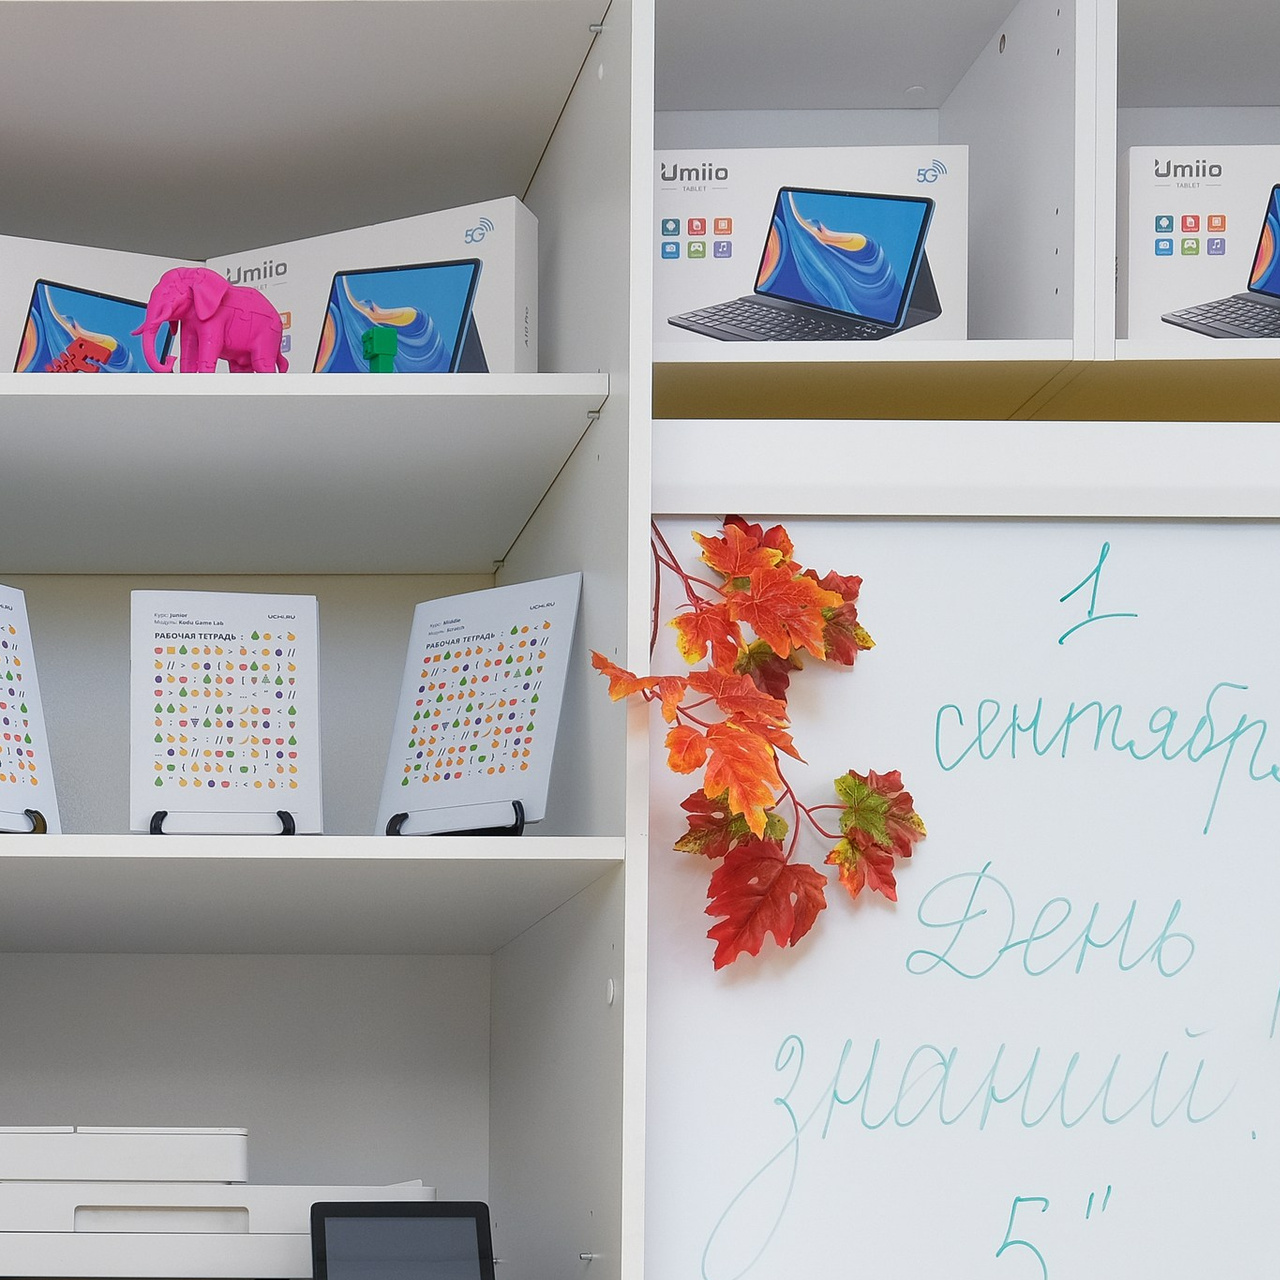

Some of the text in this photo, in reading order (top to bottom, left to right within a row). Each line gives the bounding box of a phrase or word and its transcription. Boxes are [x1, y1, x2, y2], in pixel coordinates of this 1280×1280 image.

[661, 162, 729, 182] Umiio
[1154, 158, 1222, 178] Umiio
[226, 260, 288, 285] Umiio
[154, 632, 236, 642] РАБОЧАЯ ТЕТРАДЬ
[425, 632, 495, 650] РАБОЧАЯ ТЕТРАДЬ
[935, 682, 1280, 835] сентябр
[906, 861, 1195, 979] День
